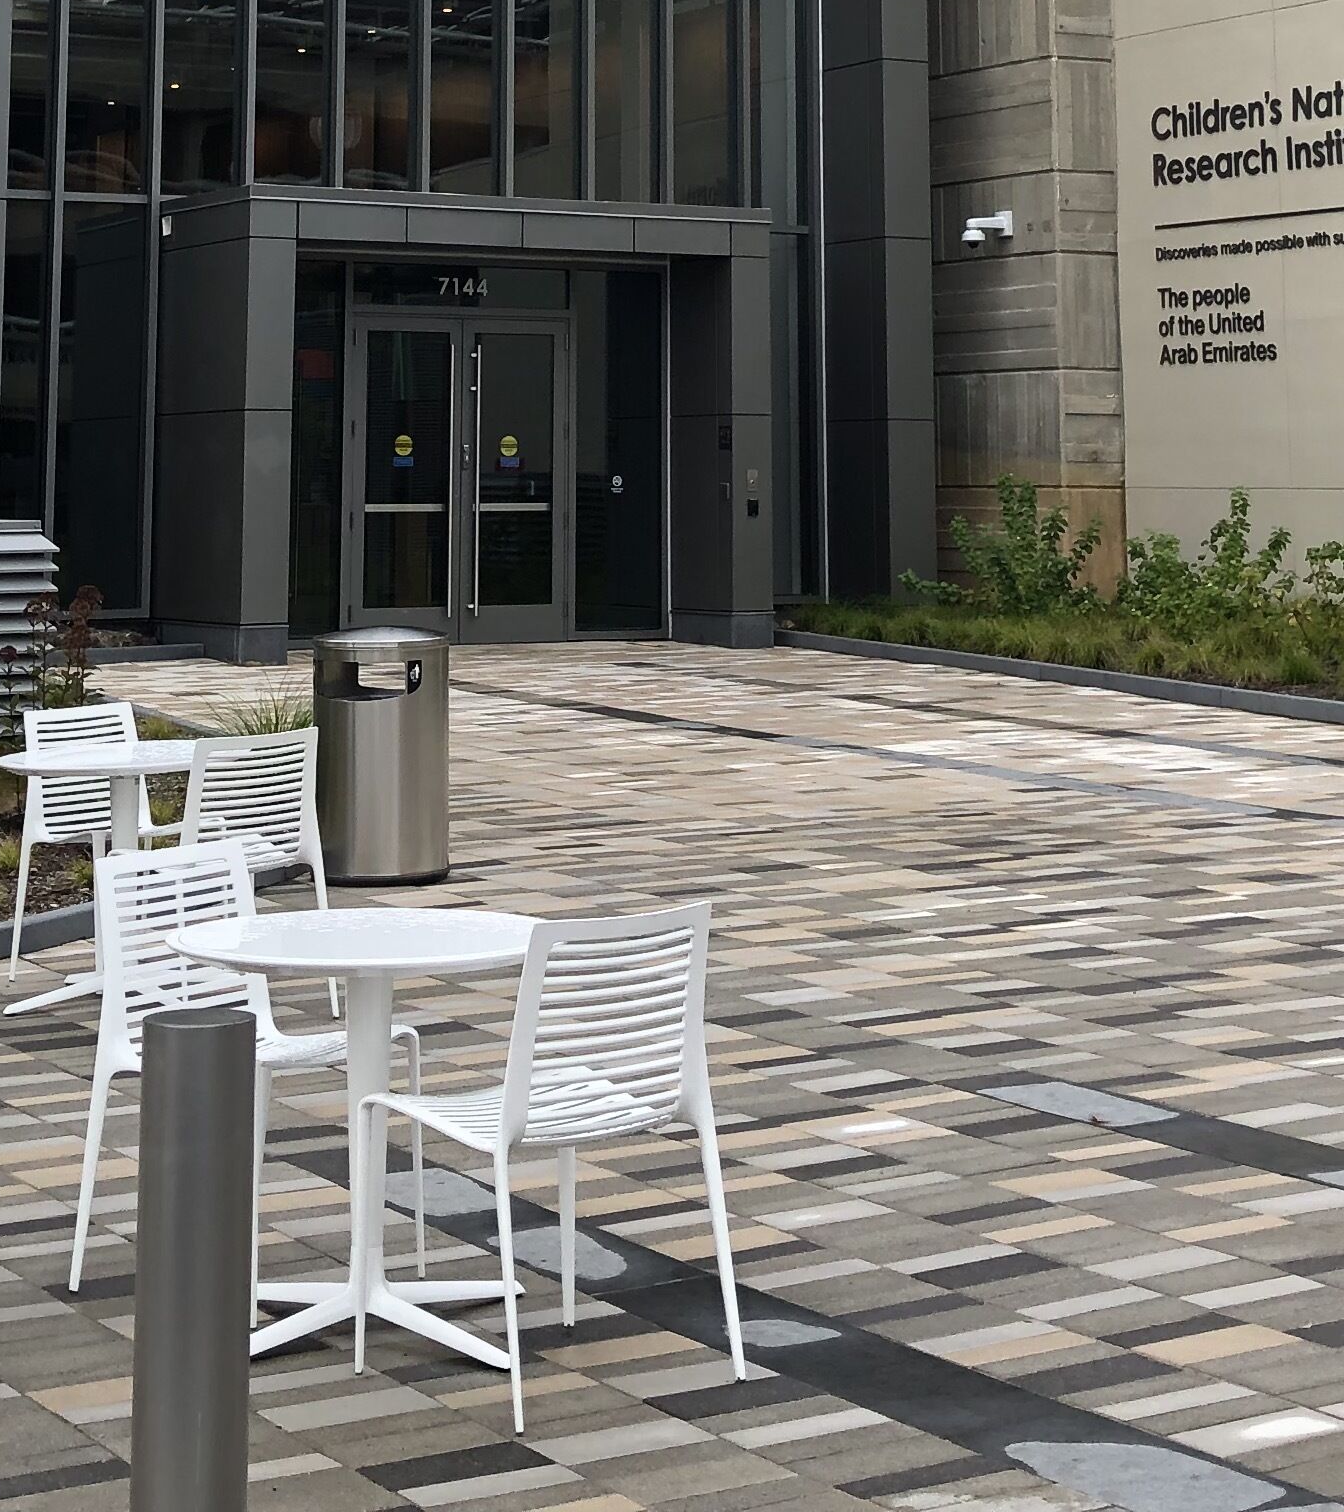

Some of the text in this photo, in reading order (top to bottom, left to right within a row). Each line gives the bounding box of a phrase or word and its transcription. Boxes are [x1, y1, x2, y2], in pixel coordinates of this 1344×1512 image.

[1151, 91, 1282, 141] Children's
[1153, 139, 1277, 186] Research
[1155, 243, 1218, 261] Discoveries
[1220, 239, 1253, 255] made
[1255, 234, 1304, 256] possible
[1306, 231, 1331, 248] with
[439, 278, 488, 296] 7144
[1157, 283, 1250, 312] The people
[1158, 310, 1264, 337] of the United
[1160, 341, 1277, 365] Arab Emirates
